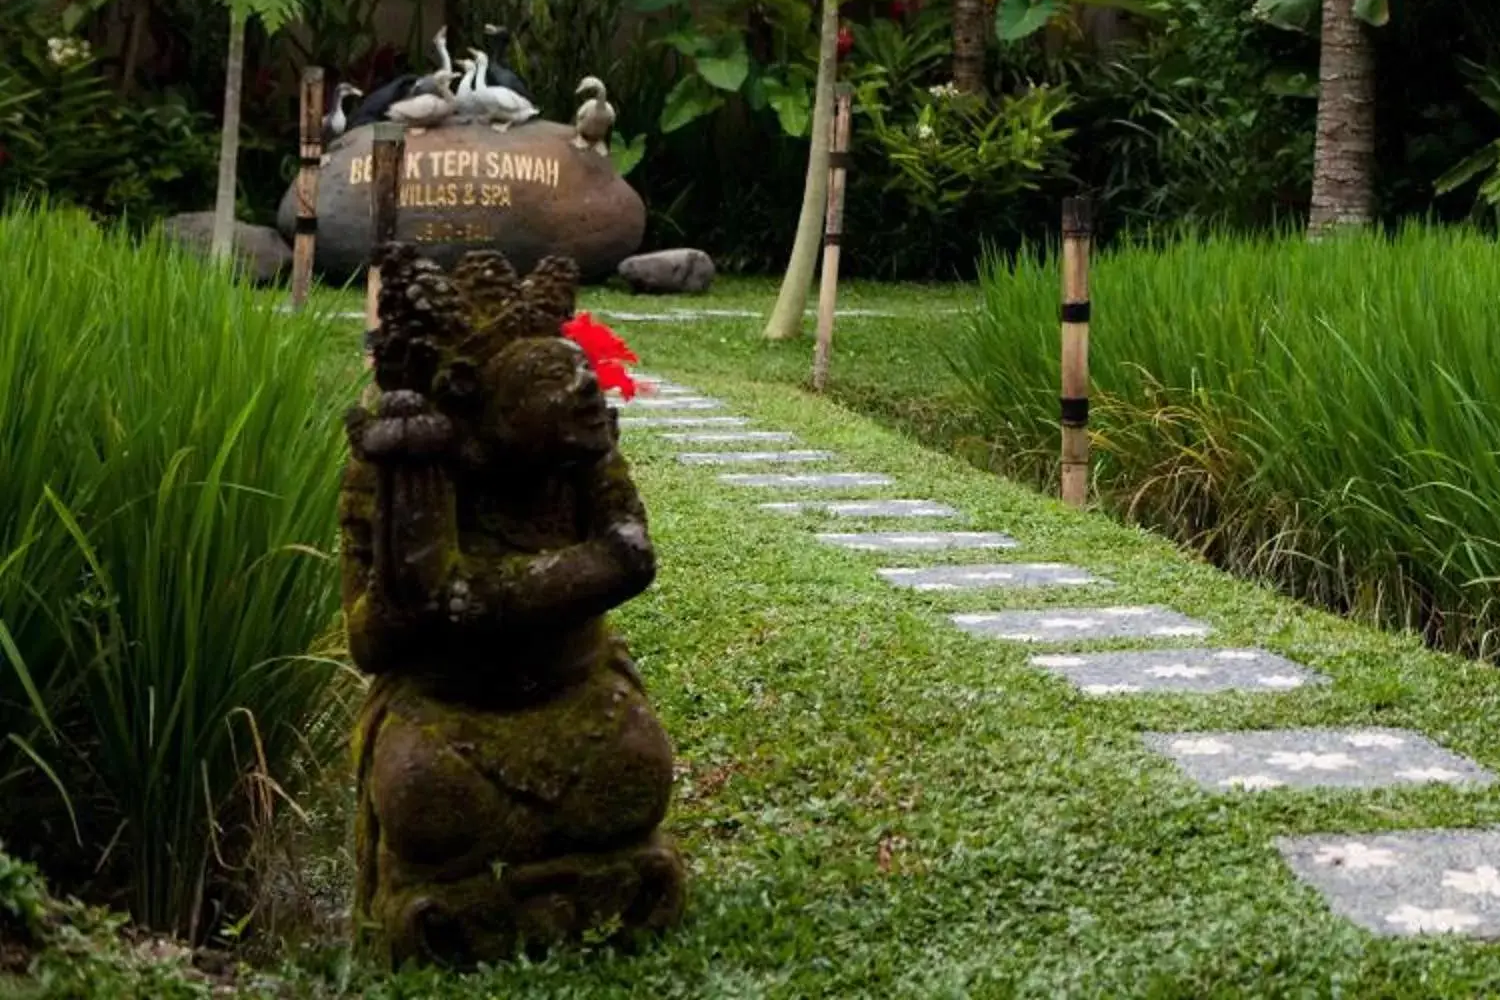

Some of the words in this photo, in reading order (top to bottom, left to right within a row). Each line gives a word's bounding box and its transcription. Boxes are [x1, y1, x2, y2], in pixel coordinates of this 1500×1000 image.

[350, 151, 422, 185] BEK
[429, 149, 479, 179] TEPI
[486, 151, 560, 189] SAWAH
[399, 183, 457, 207] VILLAS
[462, 183, 475, 206] &
[480, 183, 513, 207] SPA
